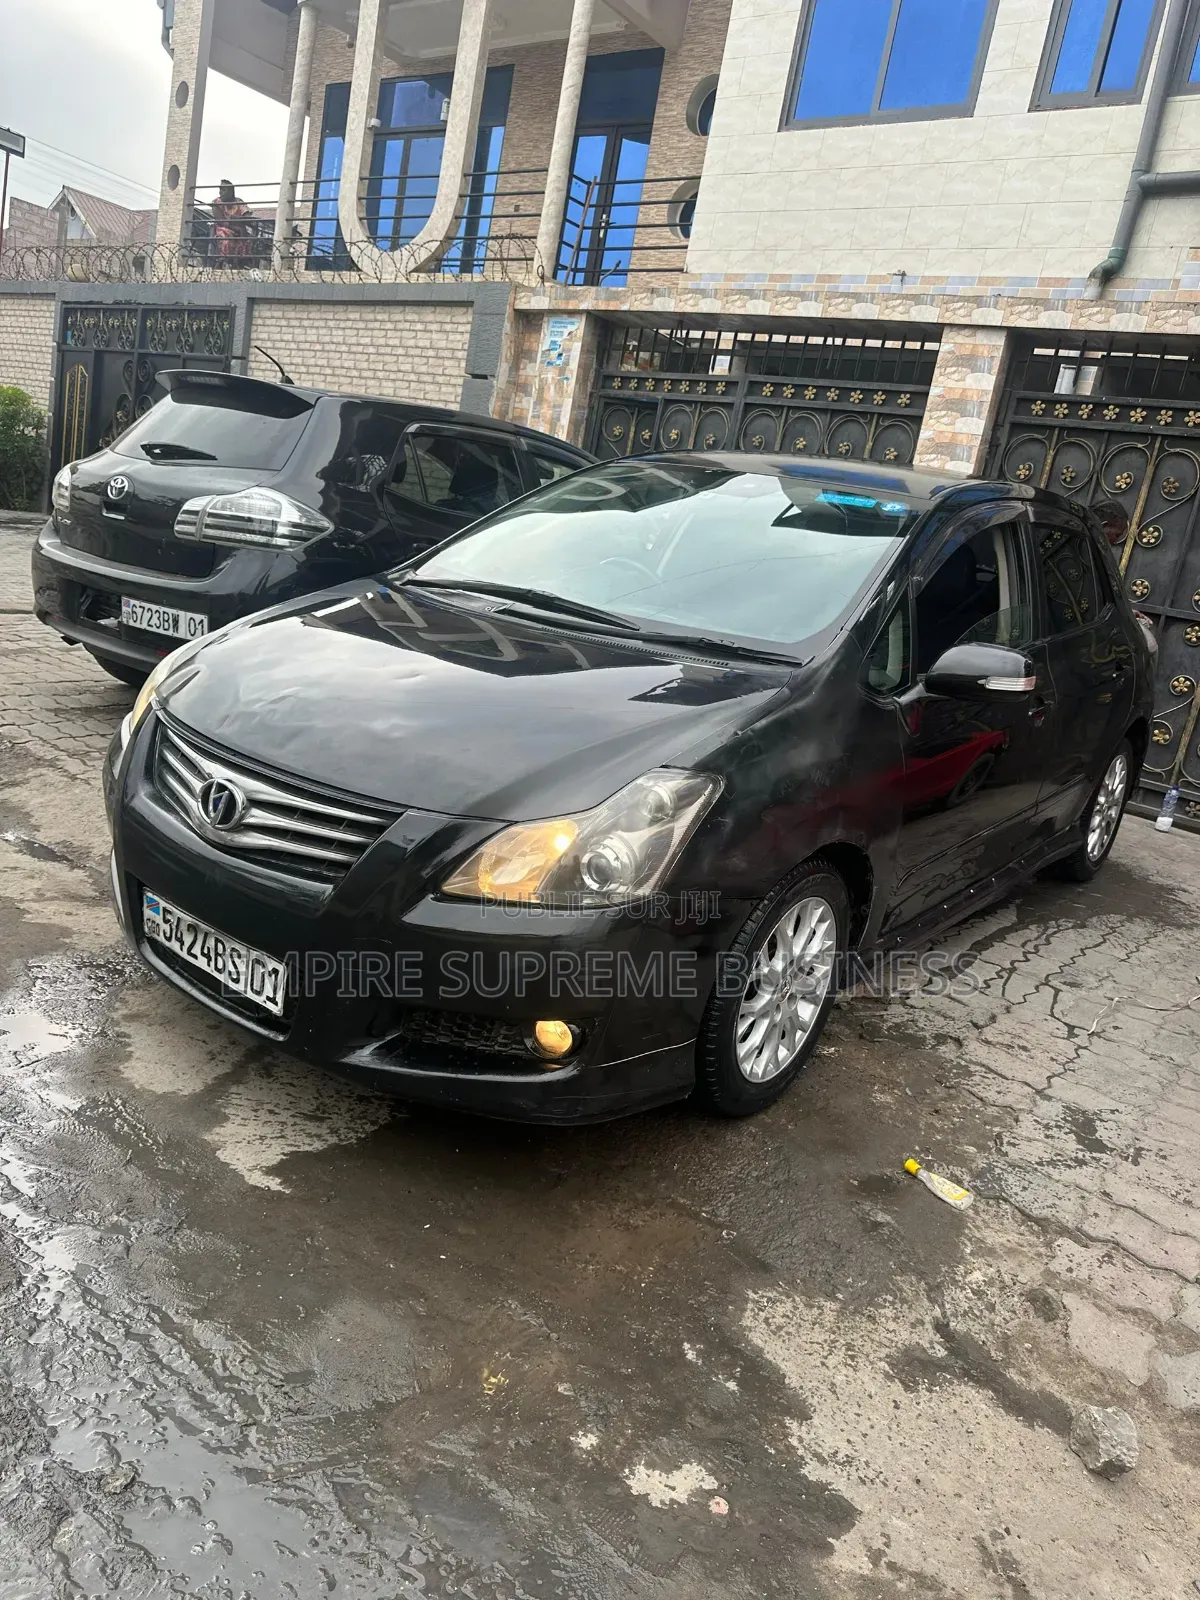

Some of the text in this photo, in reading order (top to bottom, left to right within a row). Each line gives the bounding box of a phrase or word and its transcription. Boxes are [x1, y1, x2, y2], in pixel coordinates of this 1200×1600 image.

[131, 604, 180, 634] 6723BW
[162, 906, 280, 1007] 5424BS 01
